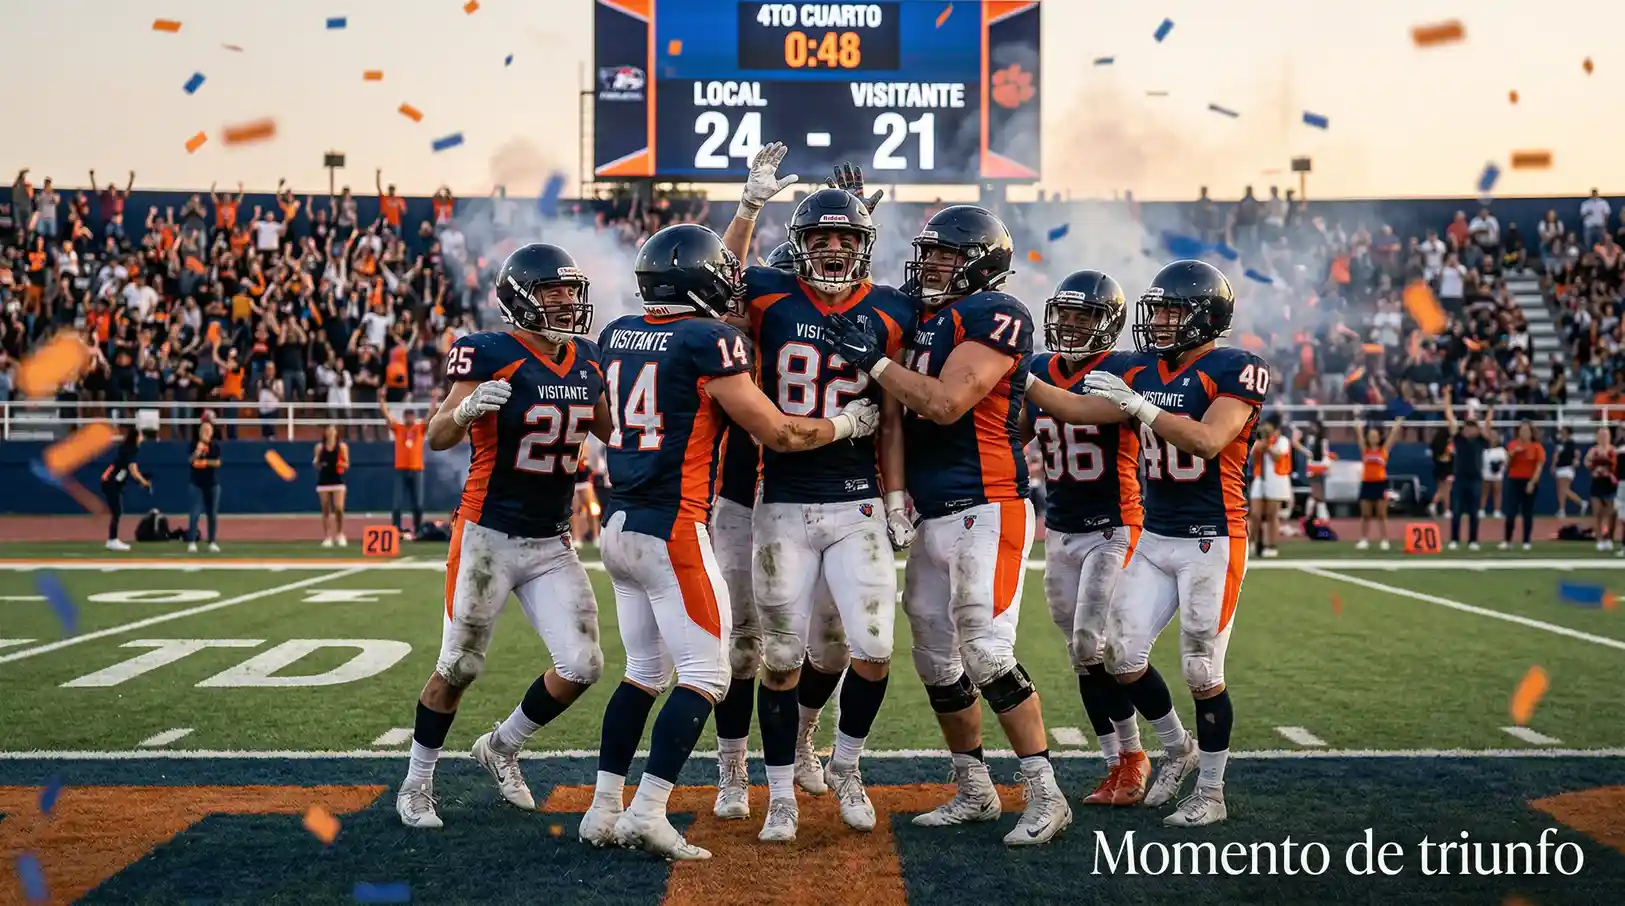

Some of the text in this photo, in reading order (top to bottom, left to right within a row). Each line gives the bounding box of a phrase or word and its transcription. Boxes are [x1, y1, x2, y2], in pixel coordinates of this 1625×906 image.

[757, 4, 882, 28] 4TO CUARTO
[785, 32, 861, 68] 0:48
[693, 82, 767, 107] LOCAL
[851, 82, 965, 108] VISITANTE
[694, 111, 766, 169] 24
[873, 112, 935, 170] 21
[610, 329, 673, 352] VISITANTE
[990, 313, 1022, 347] 71
[446, 347, 475, 375] 25
[717, 335, 750, 369] 14
[538, 385, 589, 401] VISITANTE
[776, 341, 869, 418] 82
[1238, 364, 1269, 395] 40
[606, 360, 666, 450] 14
[1142, 390, 1185, 408] VISITANTE
[514, 403, 595, 474] 25
[1034, 415, 1105, 482] 36
[366, 529, 393, 553] 20
[1411, 527, 1437, 549] 20
